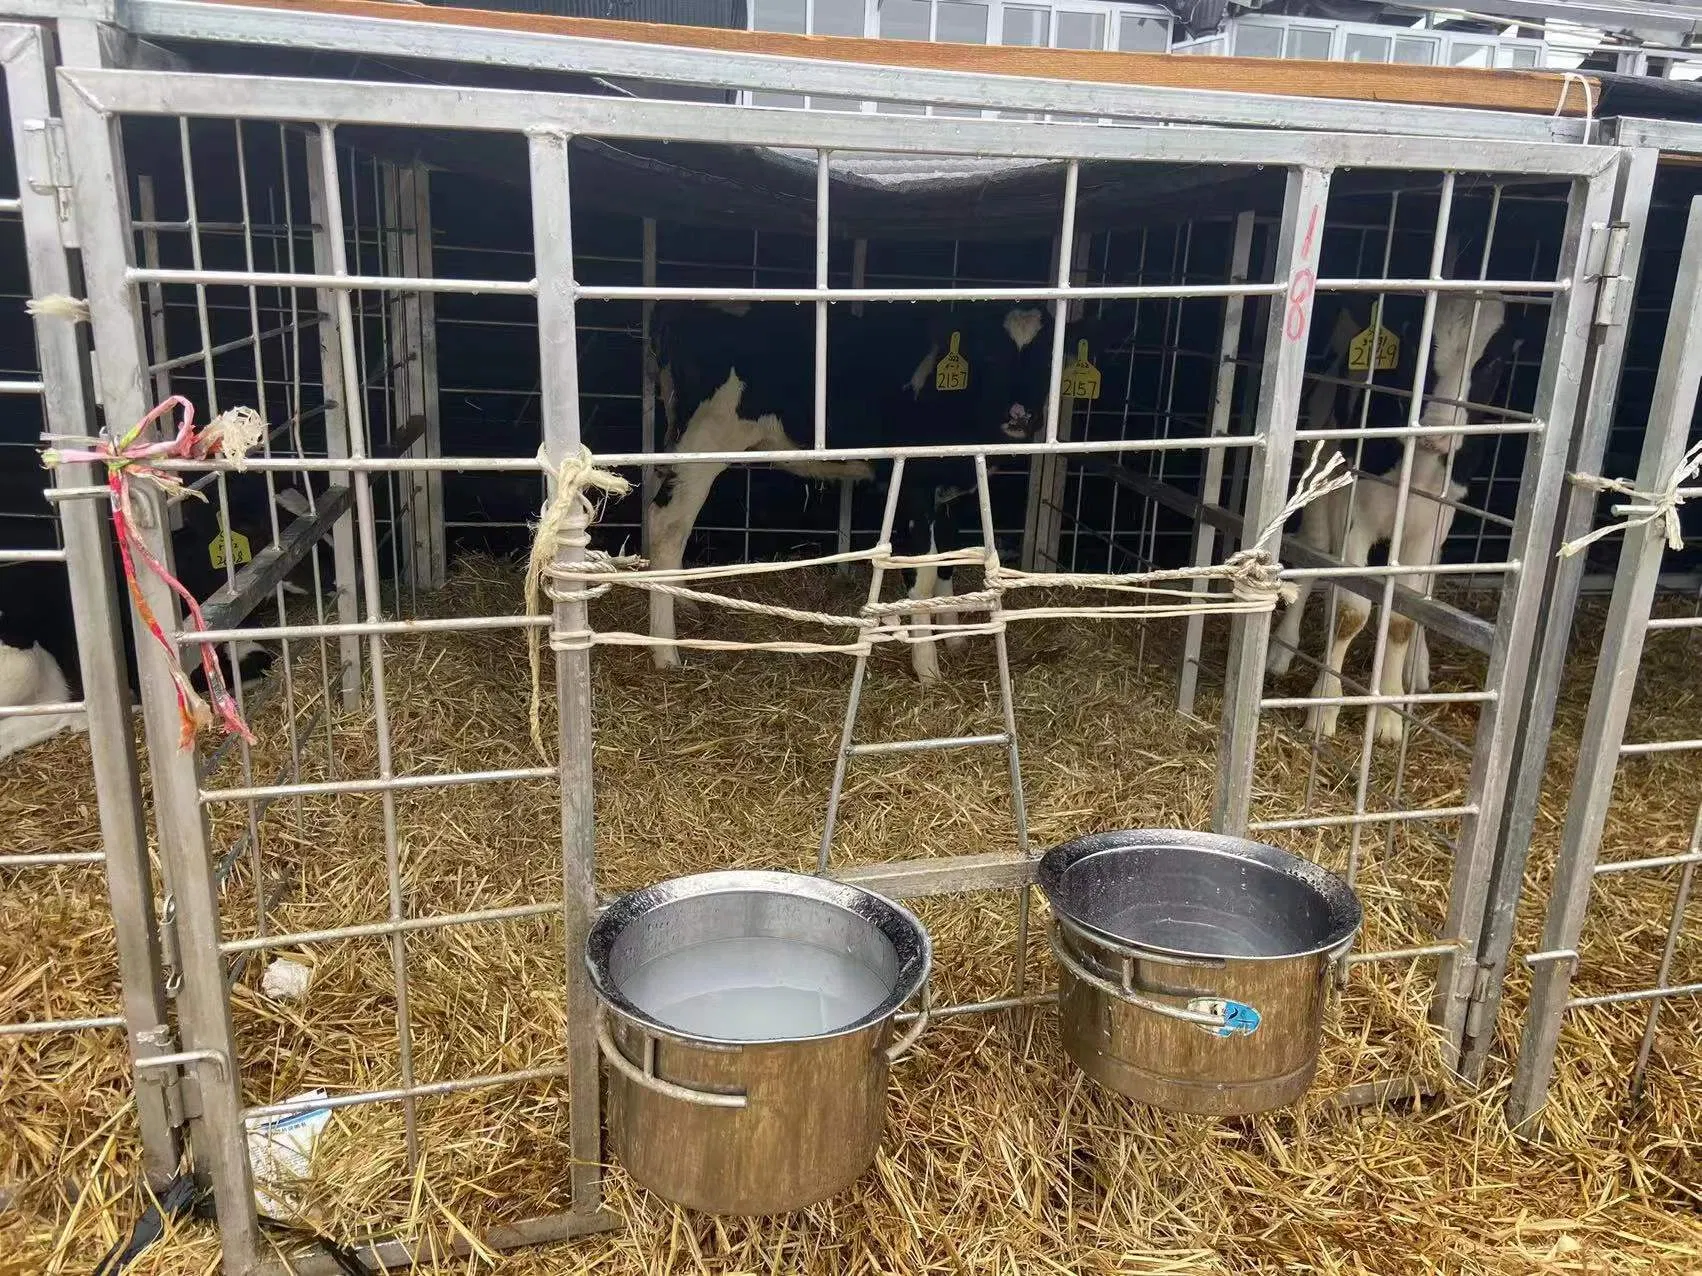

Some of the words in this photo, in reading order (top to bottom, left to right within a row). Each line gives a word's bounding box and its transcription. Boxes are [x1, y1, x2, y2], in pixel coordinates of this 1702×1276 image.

[1350, 344, 1398, 367] 2149
[938, 371, 967, 388] 2157
[1062, 379, 1097, 398] 2157
